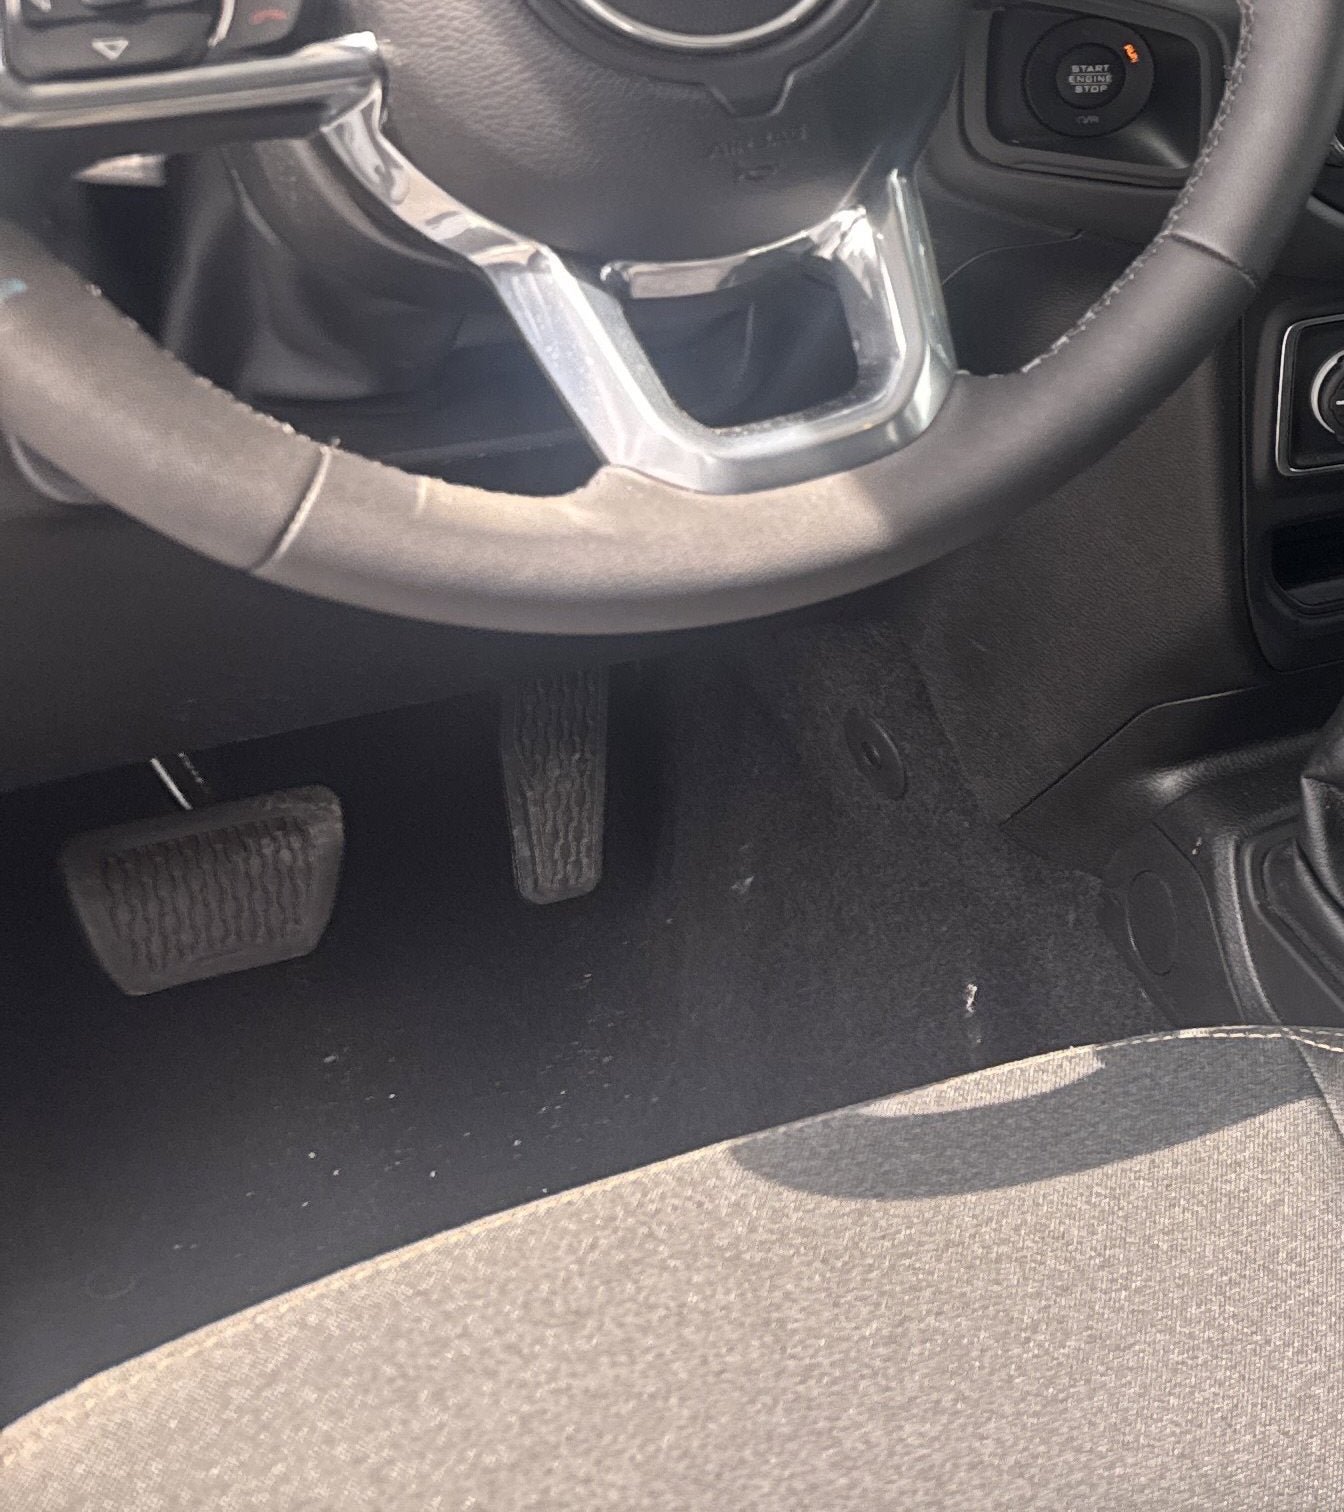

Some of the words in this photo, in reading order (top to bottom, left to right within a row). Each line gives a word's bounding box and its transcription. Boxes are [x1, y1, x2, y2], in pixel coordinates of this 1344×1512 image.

[1071, 63, 1110, 73] START
[1068, 74, 1113, 84] ENGINE
[1074, 85, 1108, 94] STOP
